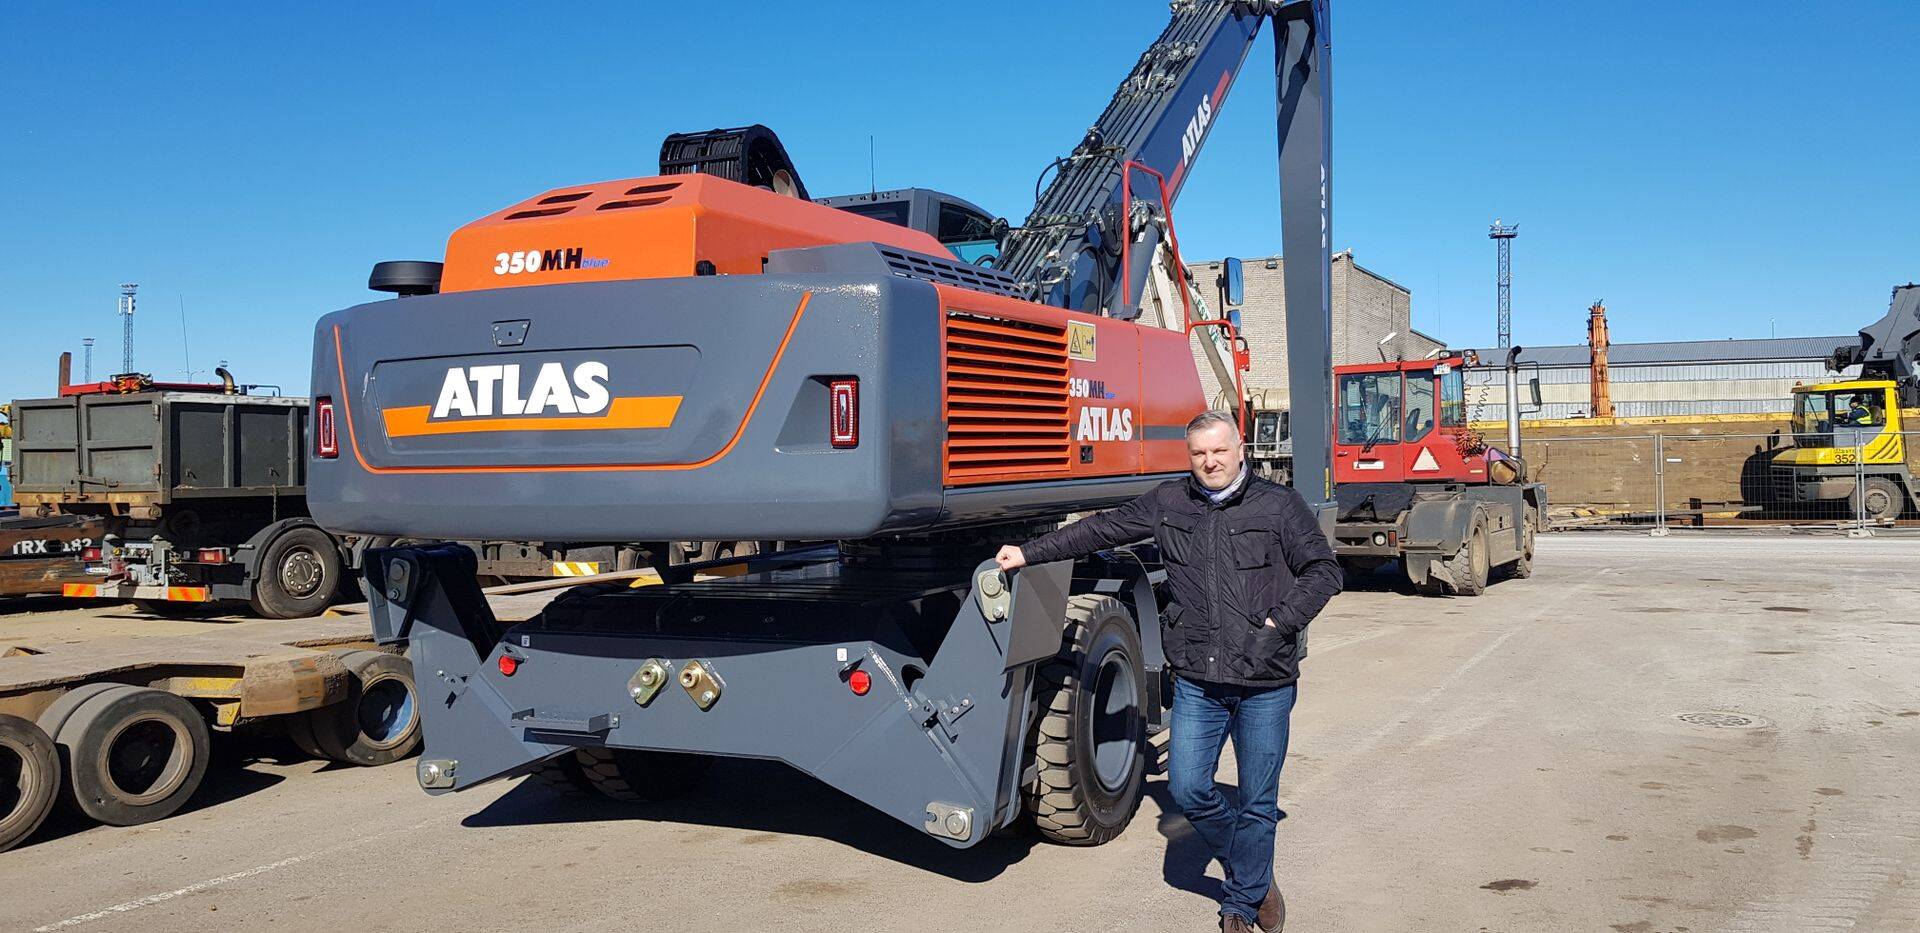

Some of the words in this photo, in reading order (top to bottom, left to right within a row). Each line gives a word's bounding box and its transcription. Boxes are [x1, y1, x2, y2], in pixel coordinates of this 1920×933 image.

[1181, 94, 1212, 168] ATLAS
[432, 361, 609, 418] ATLAS
[1076, 406, 1133, 442] ATLAS
[1835, 454, 1856, 464] 352
